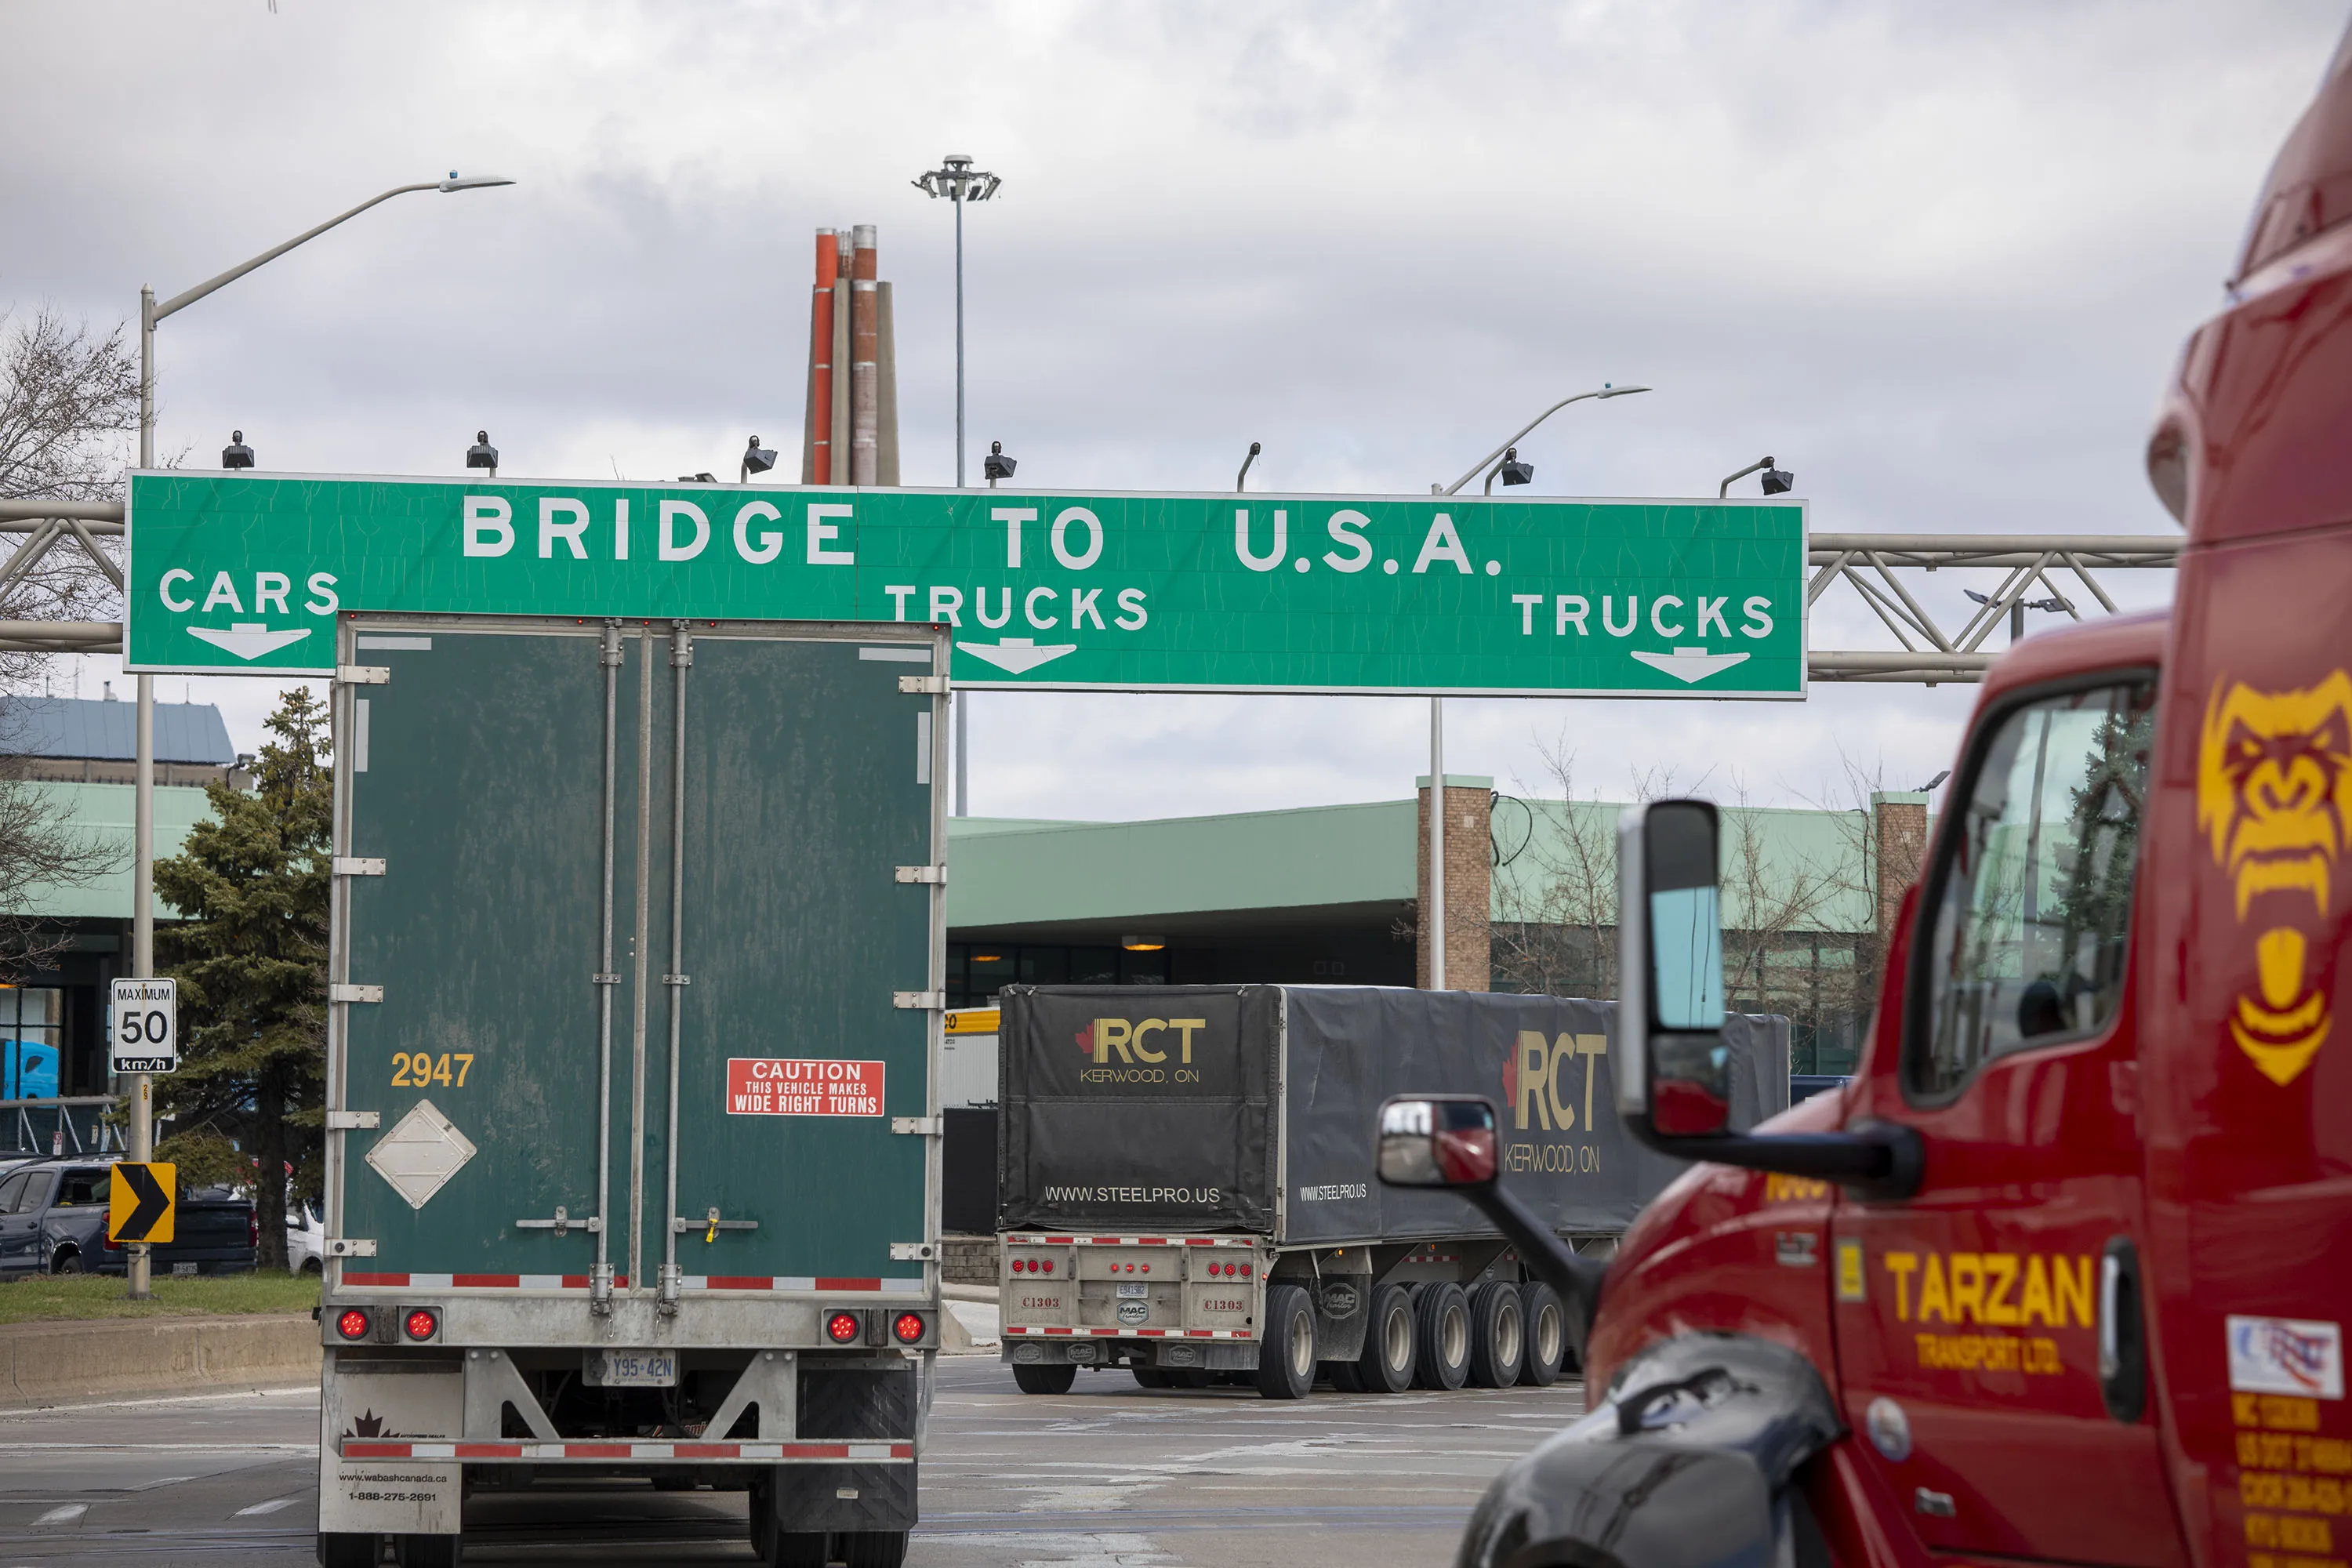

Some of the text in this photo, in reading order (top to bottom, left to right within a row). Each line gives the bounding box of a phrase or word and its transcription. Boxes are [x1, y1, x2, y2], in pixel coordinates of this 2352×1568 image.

[463, 495, 1502, 575] BRIDGE TO U.S.A.
[159, 568, 339, 616] CARS
[885, 585, 1149, 631] TRUCKS
[1512, 594, 1774, 639] TRUCKS
[118, 988, 170, 1000] MAXIMUM
[121, 1010, 168, 1044] 50
[1094, 1018, 1206, 1063] RCT
[121, 1058, 166, 1070] km/h
[390, 1051, 474, 1087] 2947
[752, 1062, 861, 1080] CAUTION
[1080, 1069, 1200, 1083] KERWOOD, ON
[1515, 1030, 1606, 1131] RCT
[746, 1081, 867, 1095] THIS VEHICLE MAKES
[735, 1094, 877, 1114] WIDE RIGHT TURNS
[1504, 1143, 1600, 1176] KERWOOD, ON
[1045, 1185, 1221, 1203] WWW.STEELPRO.US
[1300, 1183, 1367, 1202] WWW.STEELPRO.US
[1885, 1252, 2094, 1329] TARZAN
[1022, 1297, 1059, 1308] C1303
[1204, 1300, 1243, 1311] C1303
[1915, 1333, 2020, 1370] TRANSPORT
[614, 1358, 638, 1377] Y95
[647, 1358, 672, 1377] 42N
[339, 1473, 448, 1483] www.wabashcanada.ca
[348, 1492, 437, 1501] 1-888-275-2691
